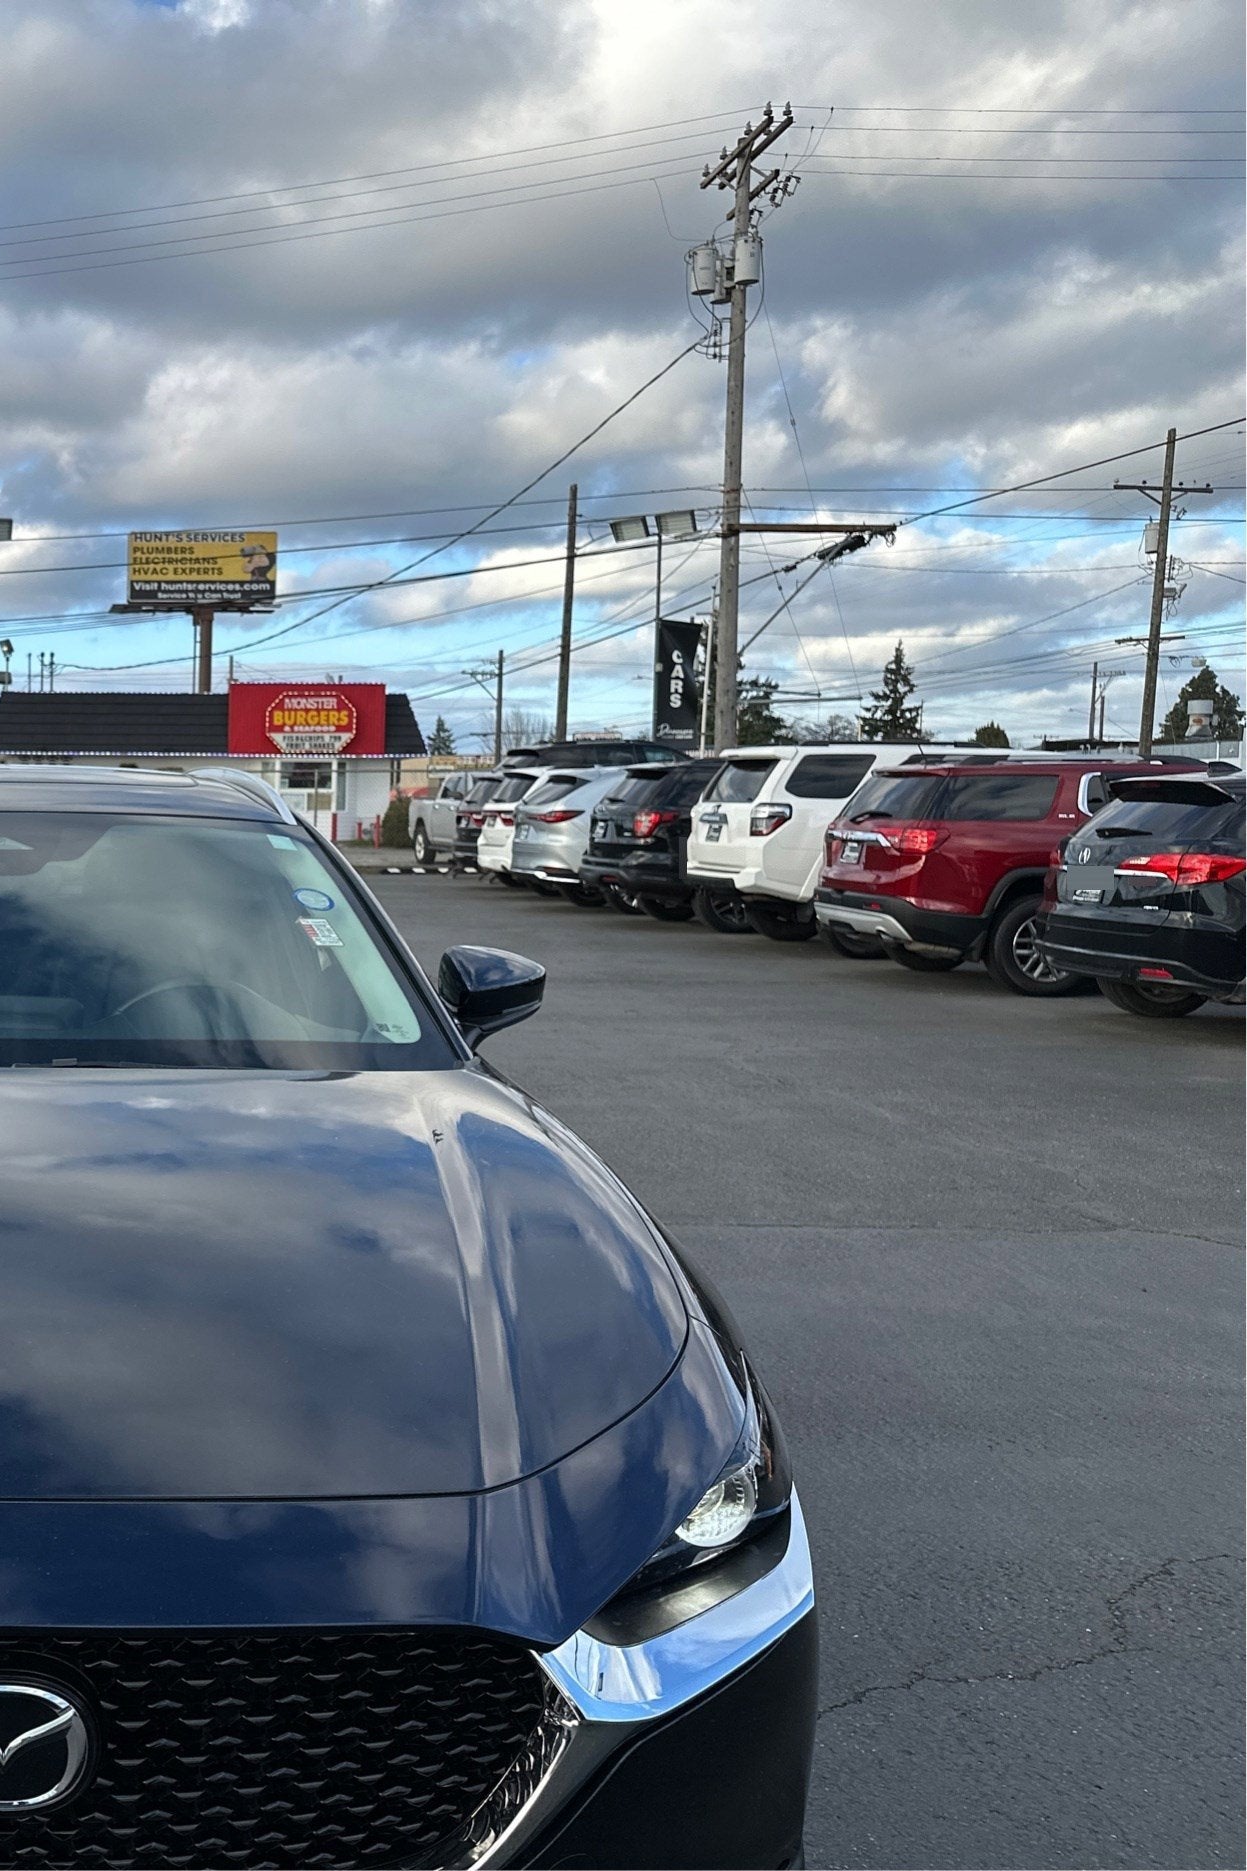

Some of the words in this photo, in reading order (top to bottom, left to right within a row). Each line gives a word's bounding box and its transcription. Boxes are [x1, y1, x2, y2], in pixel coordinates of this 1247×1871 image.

[134, 533, 183, 543] HUNT'S
[186, 533, 245, 543] SERVICES
[133, 546, 195, 555] PLUMBERS
[132, 557, 218, 566] ELECTRICIANS
[133, 567, 169, 576] HVAC
[173, 567, 224, 576] EXPERTS
[133, 582, 158, 591] Visit
[157, 592, 187, 600] Service
[204, 592, 222, 600] Can
[222, 592, 242, 600] Trust
[669, 649, 684, 709] CARS
[284, 697, 337, 709] MONSTER
[273, 710, 349, 726] BURGERS
